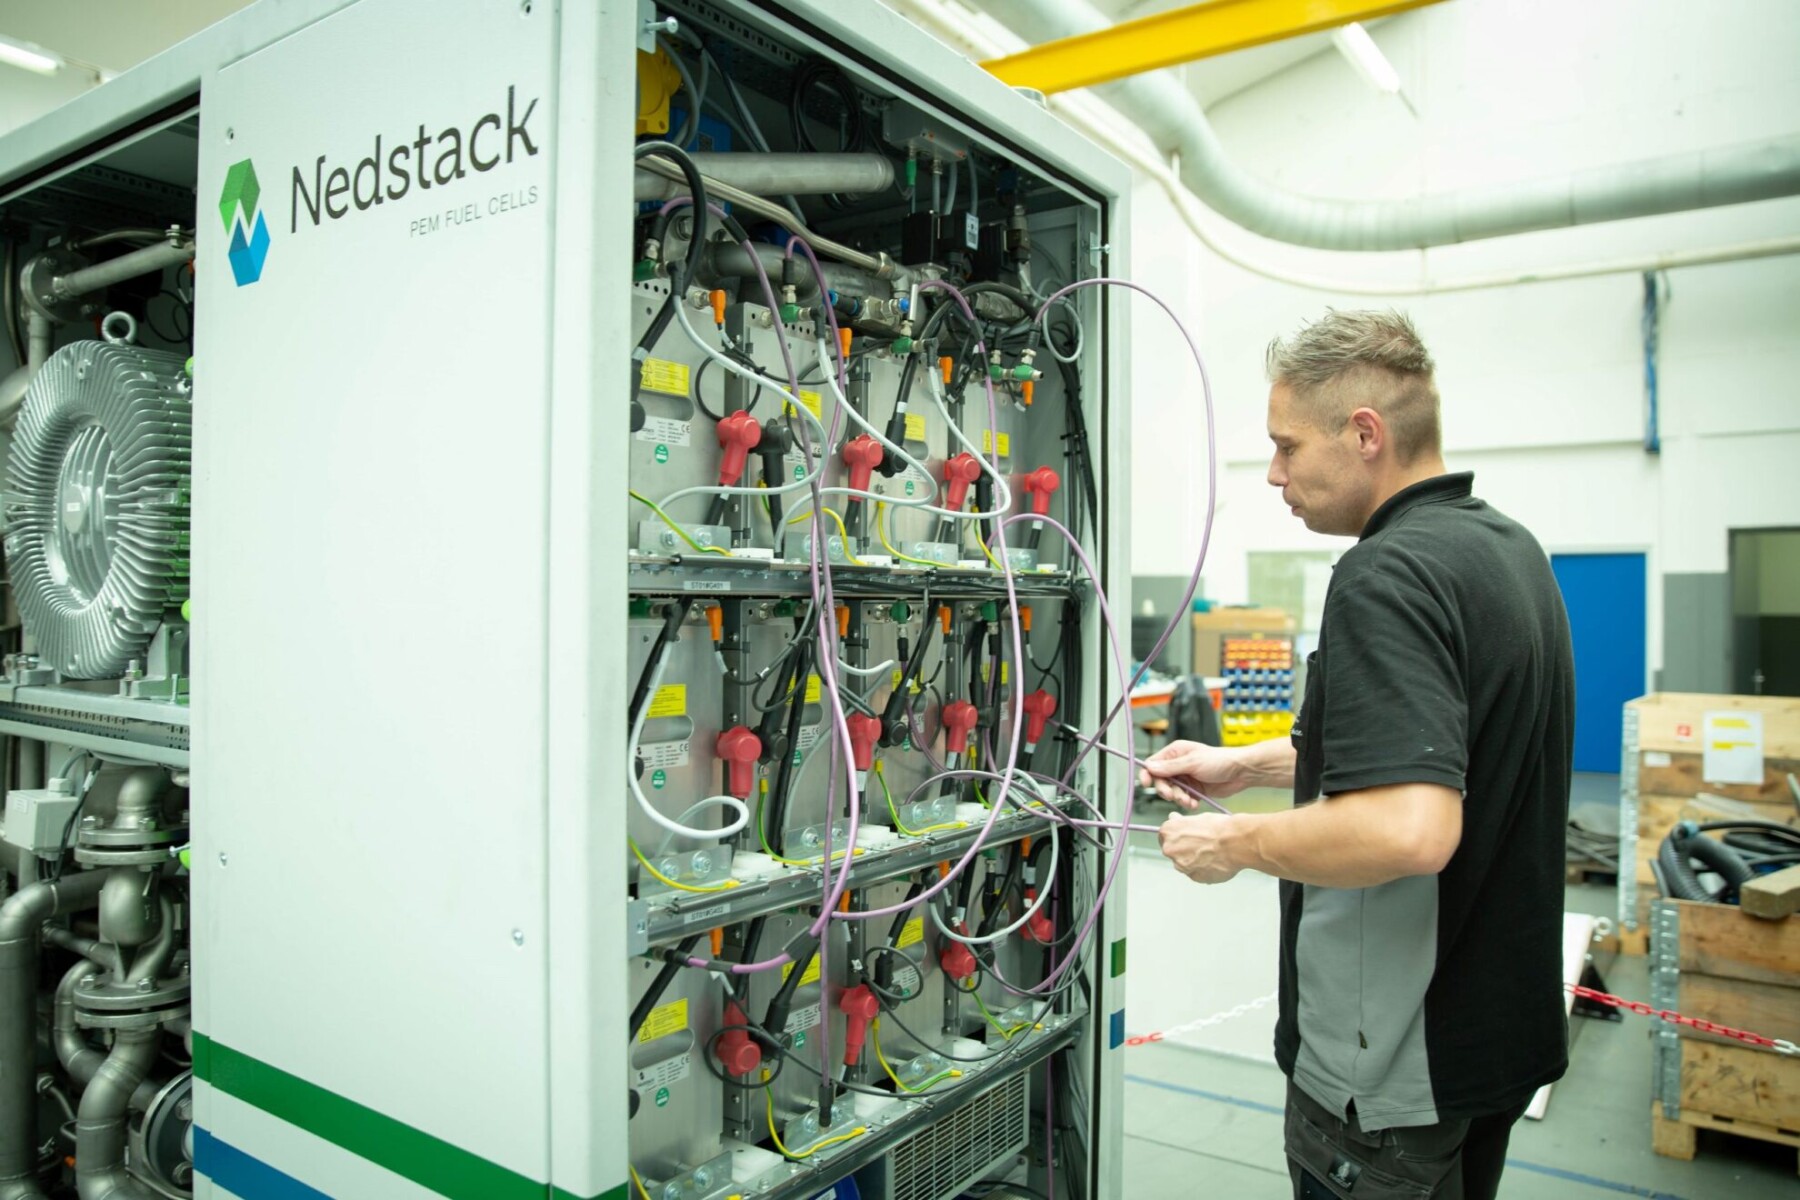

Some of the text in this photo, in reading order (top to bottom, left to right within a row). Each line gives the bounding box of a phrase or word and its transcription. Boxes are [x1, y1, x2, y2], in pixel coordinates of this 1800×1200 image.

[291, 84, 539, 234] Nedstack
[409, 186, 538, 238] PEM FUEL CELLS
